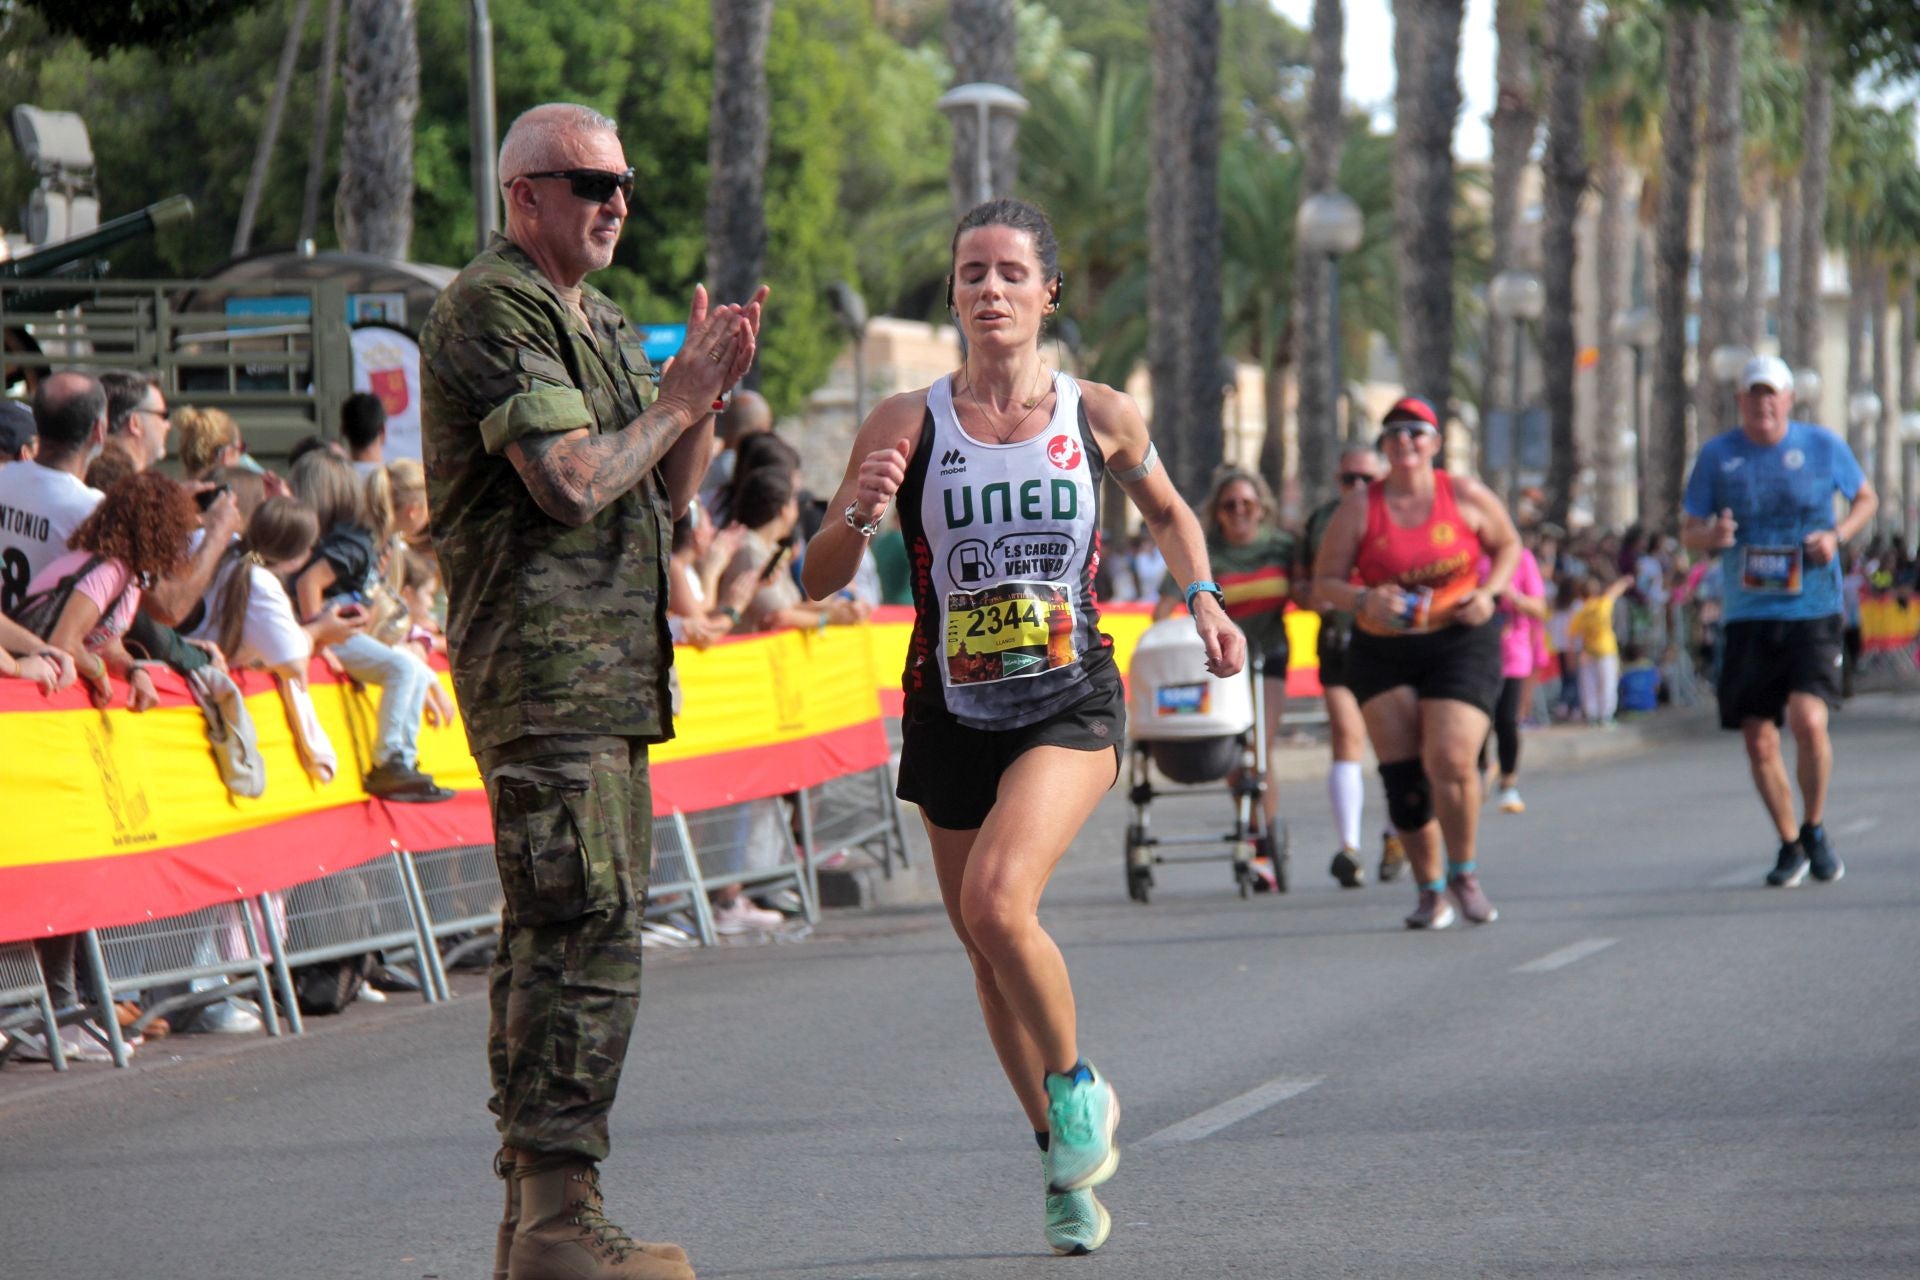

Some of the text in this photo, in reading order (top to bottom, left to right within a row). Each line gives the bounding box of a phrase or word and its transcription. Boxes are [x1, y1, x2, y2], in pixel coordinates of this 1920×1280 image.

[940, 465, 967, 476] mobel
[943, 479, 1077, 530] UNED
[1004, 542, 1068, 558] E.S CABEZO
[1004, 557, 1064, 577] VENTURA
[966, 601, 1041, 638] 2344
